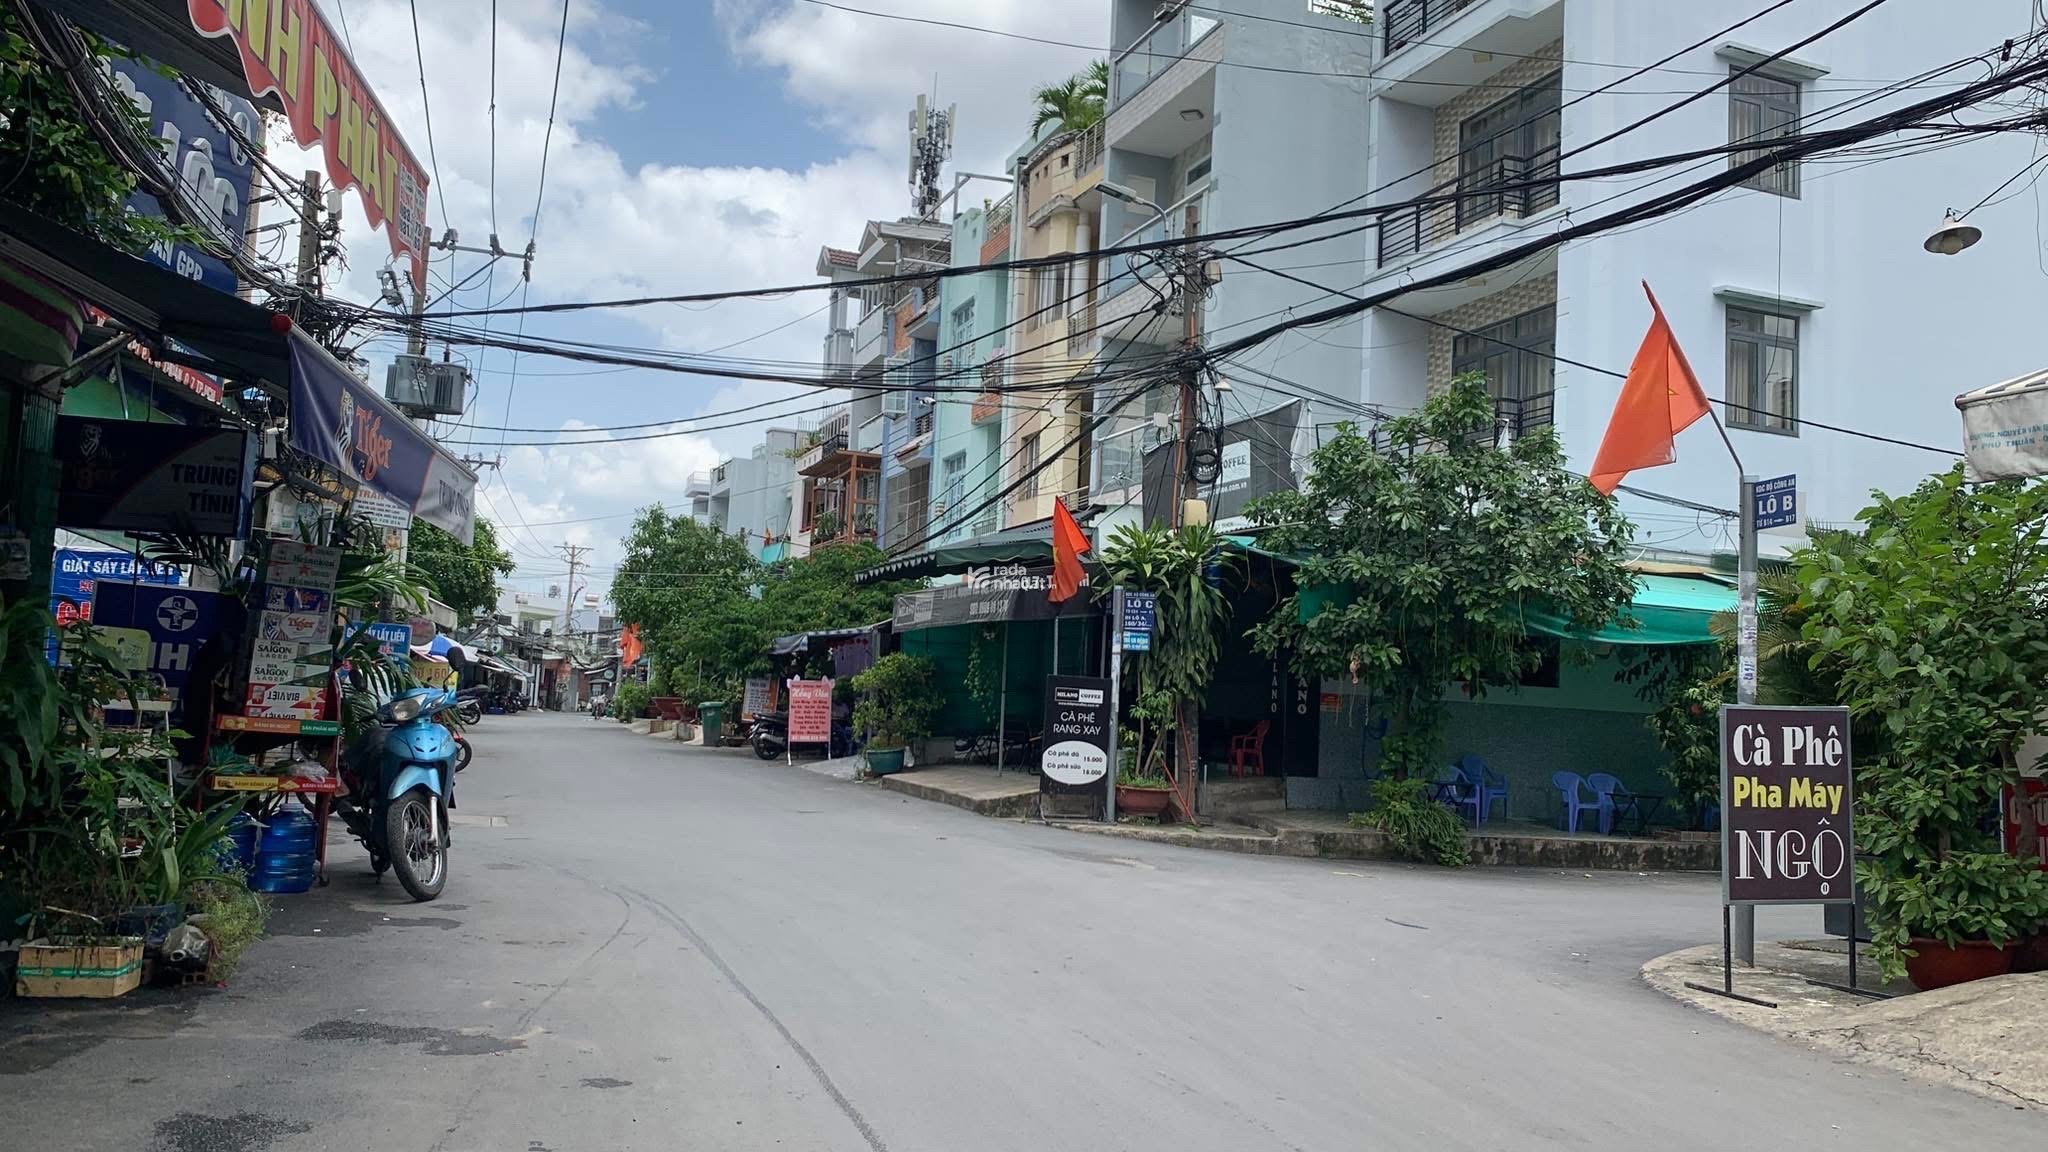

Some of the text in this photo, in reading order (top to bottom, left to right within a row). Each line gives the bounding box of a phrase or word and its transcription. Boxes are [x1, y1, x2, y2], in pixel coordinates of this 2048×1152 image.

[313, 43, 398, 224] PHÁT
[176, 249, 204, 282] GPP
[355, 405, 393, 481] Tiger
[1222, 455, 1247, 470] OFFEE
[171, 464, 237, 487] TRUNG
[1758, 494, 1792, 515] LÔ B
[62, 558, 90, 574] GIẶT
[92, 557, 118, 574] SẤY
[1127, 598, 1153, 608] LÔ C
[257, 645, 292, 654] SAIGON
[254, 666, 288, 676] SAIGON
[1060, 710, 1095, 723] CÀ PHÊ
[1053, 723, 1101, 735] RANG XAY
[1733, 723, 1843, 767] Cà Phê
[1733, 776, 1843, 815] Pha Máy
[1734, 817, 1845, 895] NGỘ
